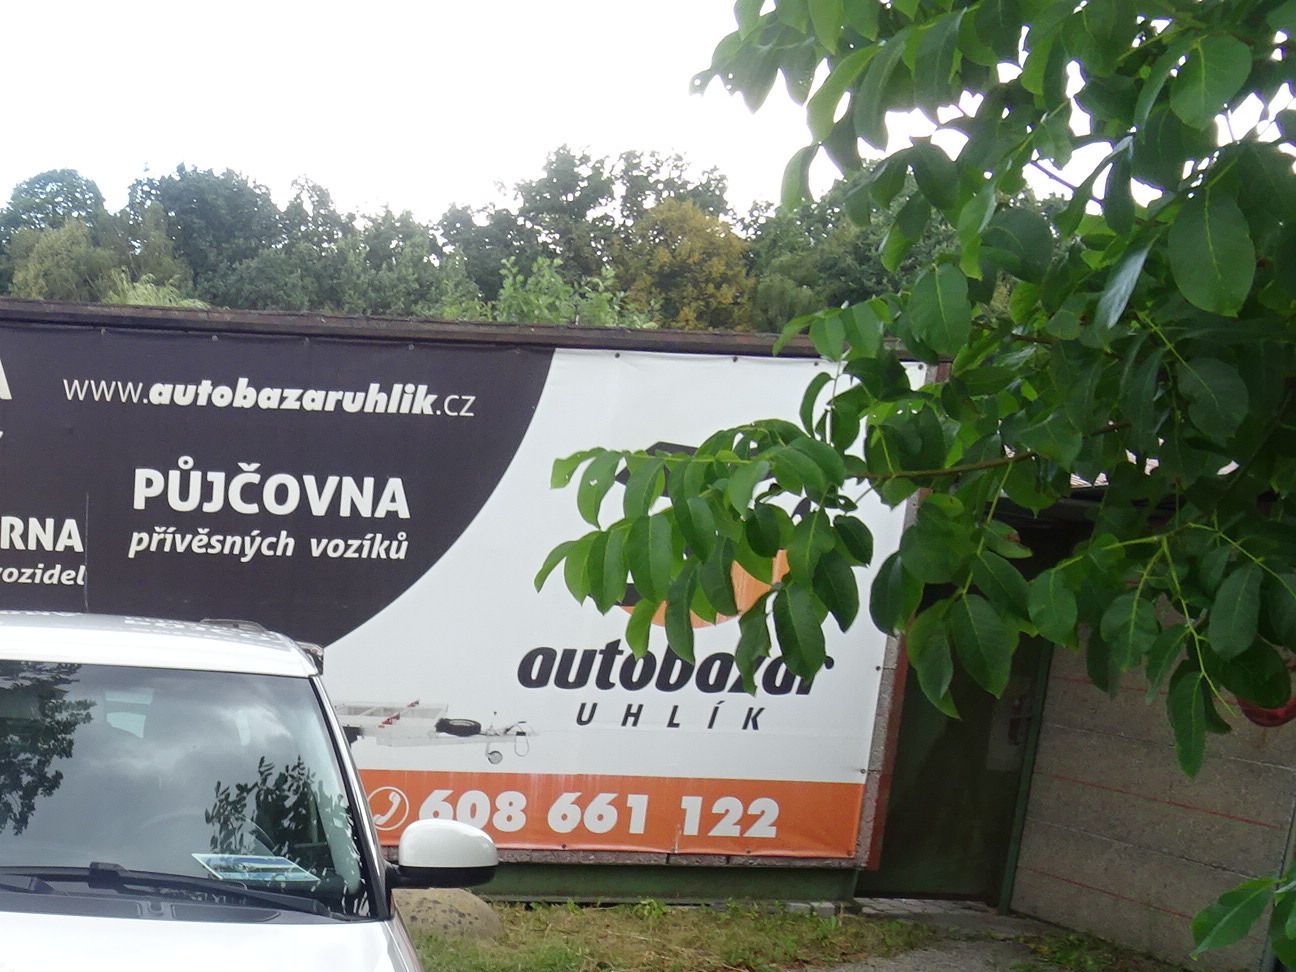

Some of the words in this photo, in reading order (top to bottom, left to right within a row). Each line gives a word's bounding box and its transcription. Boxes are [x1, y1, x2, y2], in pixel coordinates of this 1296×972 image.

[62, 377, 477, 417] www.autobazaruhlik.cz
[132, 455, 411, 519] PŮJČOVNA
[127, 526, 295, 563] přívěsných
[309, 532, 409, 560] vozíků
[575, 700, 766, 731] UHLÍK
[418, 789, 528, 833] 608
[547, 791, 650, 835] 661
[680, 795, 781, 839] 122
